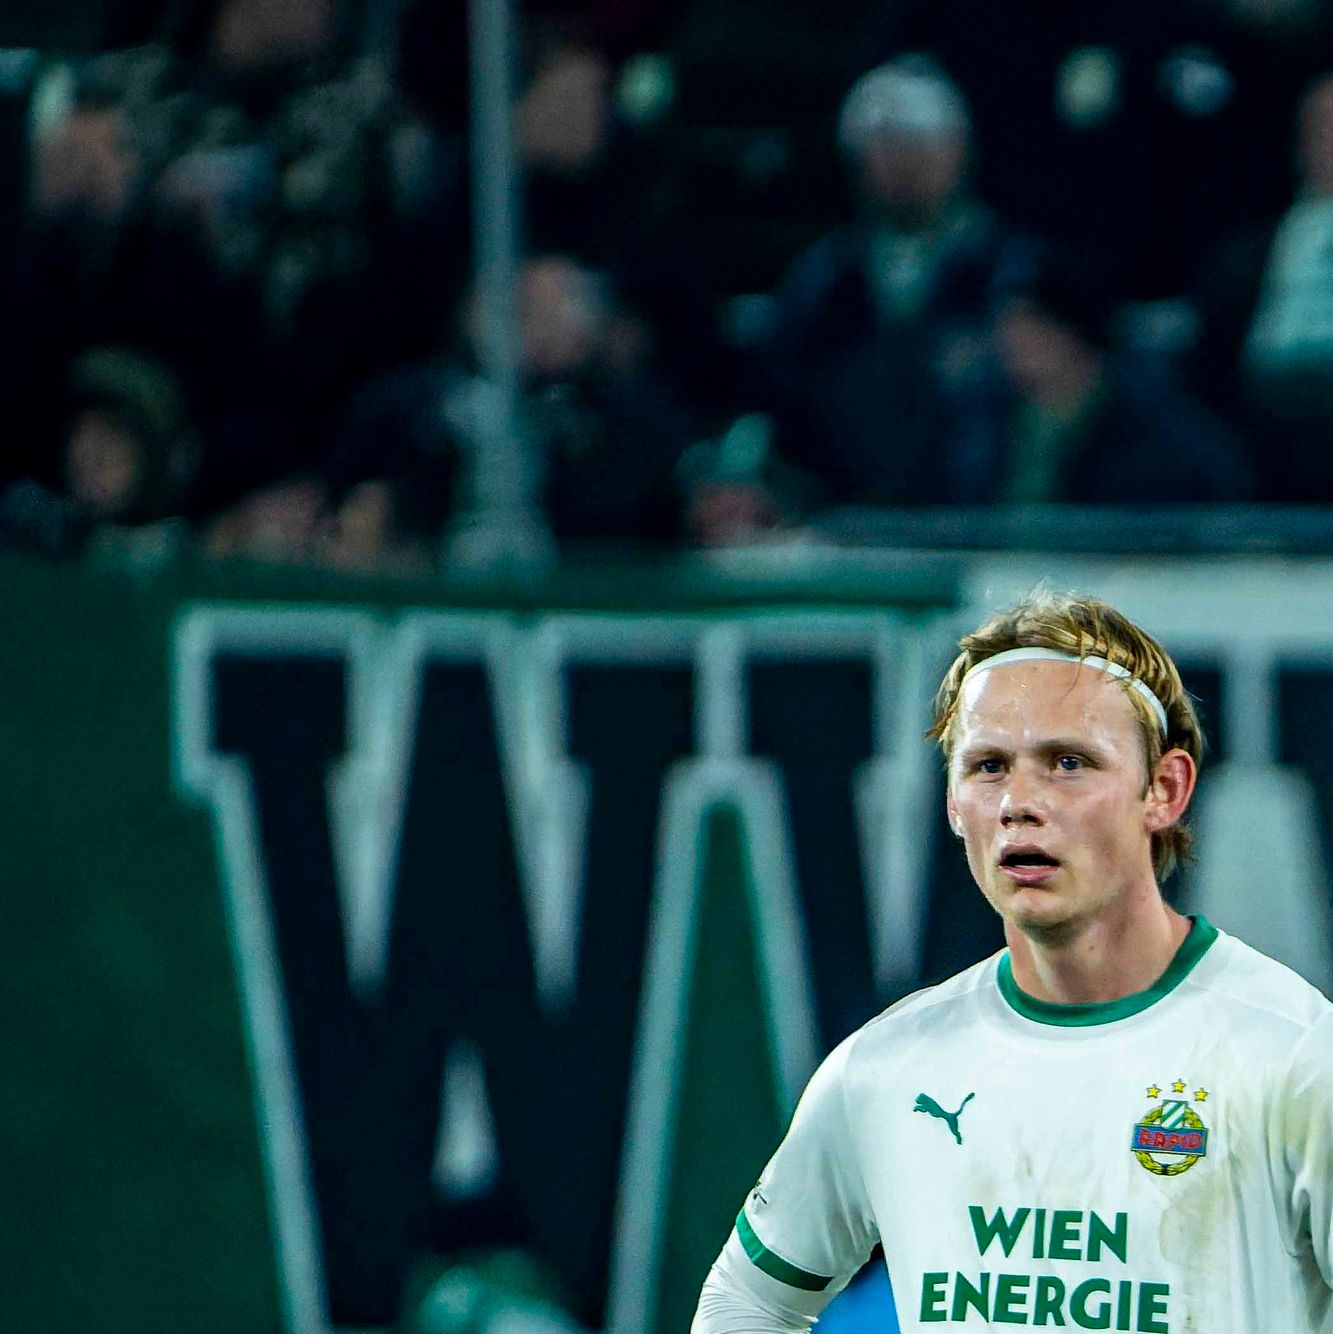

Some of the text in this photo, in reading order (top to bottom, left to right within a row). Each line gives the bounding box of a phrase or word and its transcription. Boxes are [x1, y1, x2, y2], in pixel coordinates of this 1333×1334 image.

[1138, 1128, 1203, 1150] RAPID
[968, 1205, 1128, 1264] WIEN
[919, 1271, 1170, 1334] ENERGIE
